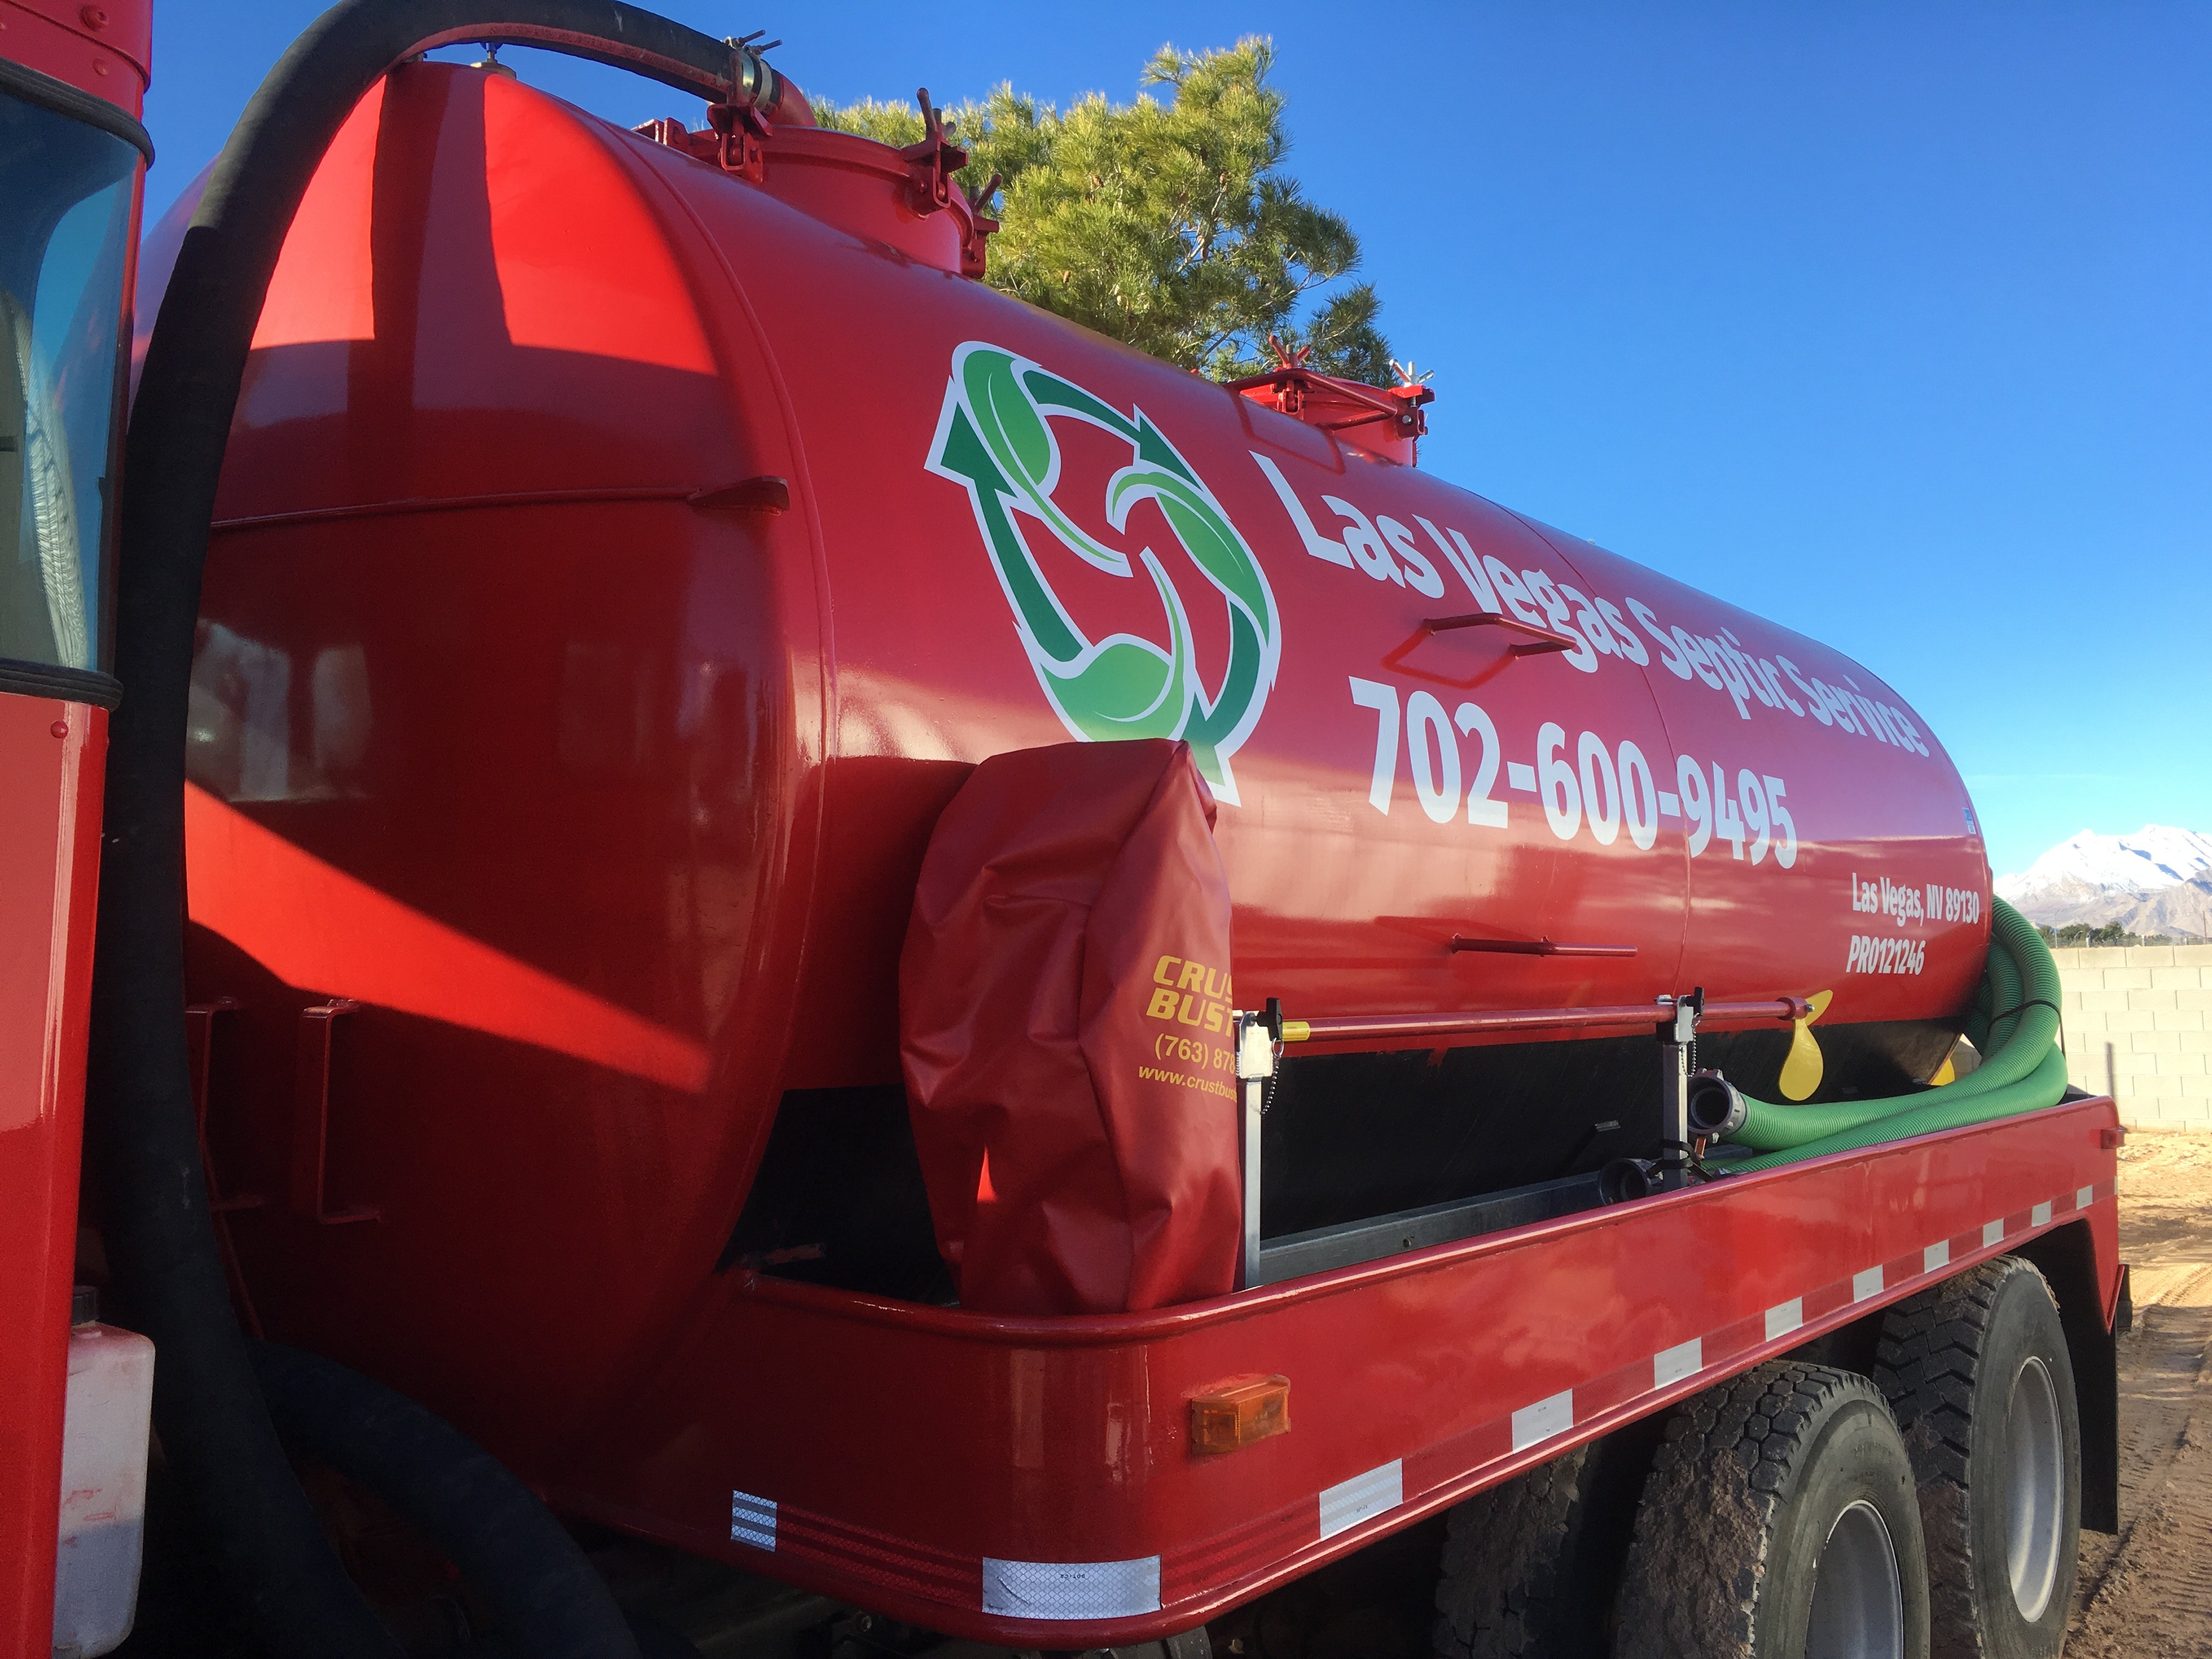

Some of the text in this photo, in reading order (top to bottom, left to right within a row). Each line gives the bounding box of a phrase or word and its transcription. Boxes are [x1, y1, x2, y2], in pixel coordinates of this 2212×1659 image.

[1249, 450, 1929, 757] Las Vegas Septic Service
[1348, 676, 1797, 868] 702-600-9495
[1852, 872, 1979, 927] Las Vegas, NV 89130
[1155, 1033, 1235, 1074] (763) 878
